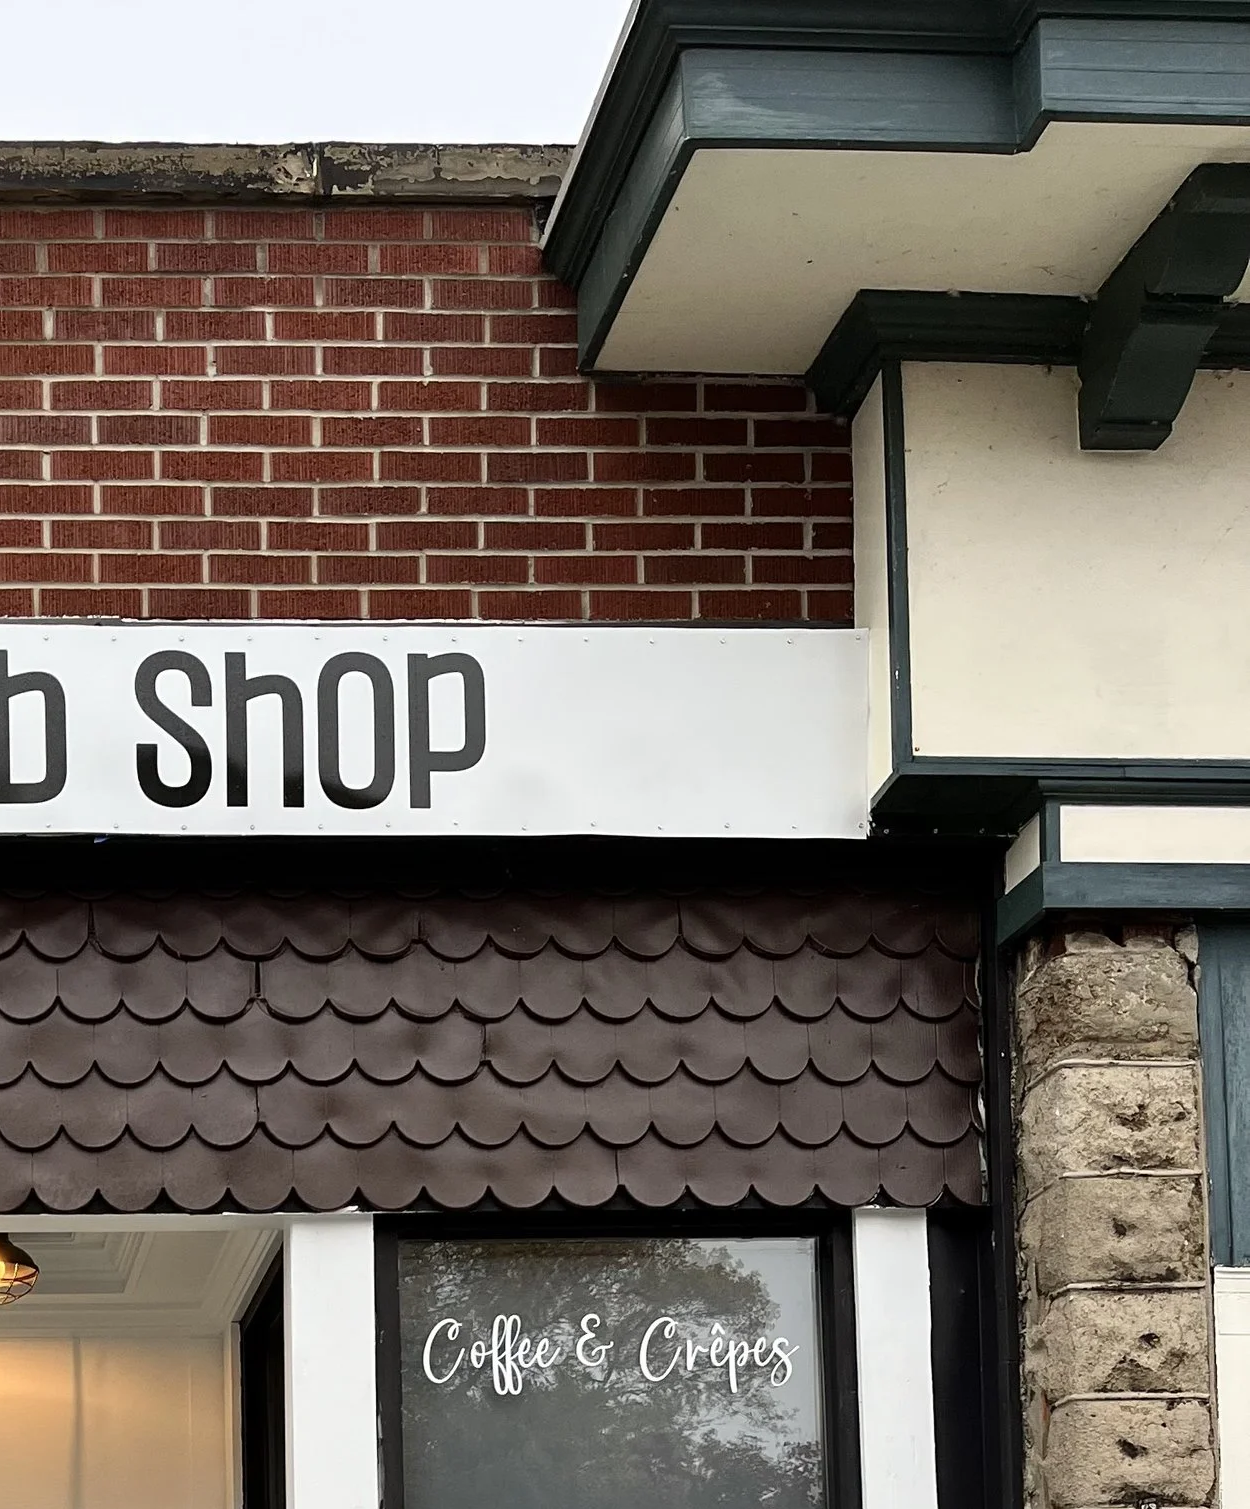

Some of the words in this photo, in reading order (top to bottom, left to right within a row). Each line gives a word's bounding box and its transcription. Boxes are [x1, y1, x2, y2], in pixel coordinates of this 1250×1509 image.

[134, 649, 486, 810] shop
[422, 1314, 564, 1396] Coffee
[576, 1312, 614, 1368] &
[639, 1315, 800, 1394] Crêpes
